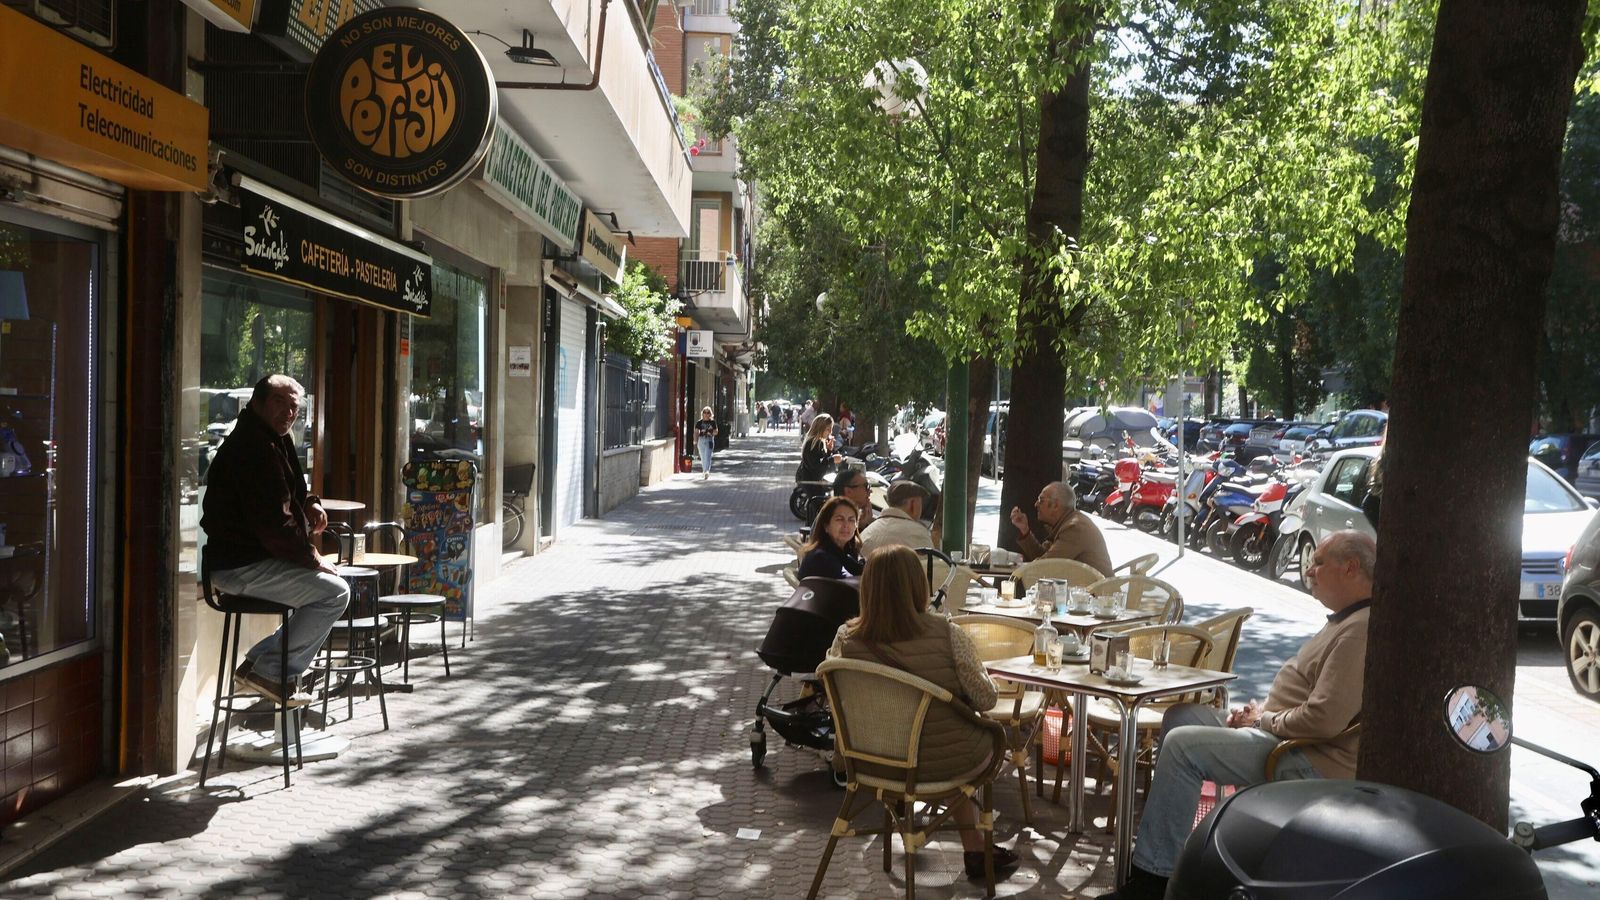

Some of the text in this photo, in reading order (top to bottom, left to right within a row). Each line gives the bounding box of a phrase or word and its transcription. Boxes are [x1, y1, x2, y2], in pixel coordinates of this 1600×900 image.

[340, 29, 361, 48] NO
[362, 17, 393, 34] SON
[396, 16, 461, 52] MEJORES
[372, 43, 424, 80] EL
[80, 63, 154, 119] Electricidad
[78, 102, 197, 172] Telecomunicaciones
[344, 158, 447, 186] SON DISTINTOS
[535, 170, 552, 220] DEL
[301, 238, 350, 278] CAFETERÍA
[355, 257, 398, 293] PASTELERÍA
